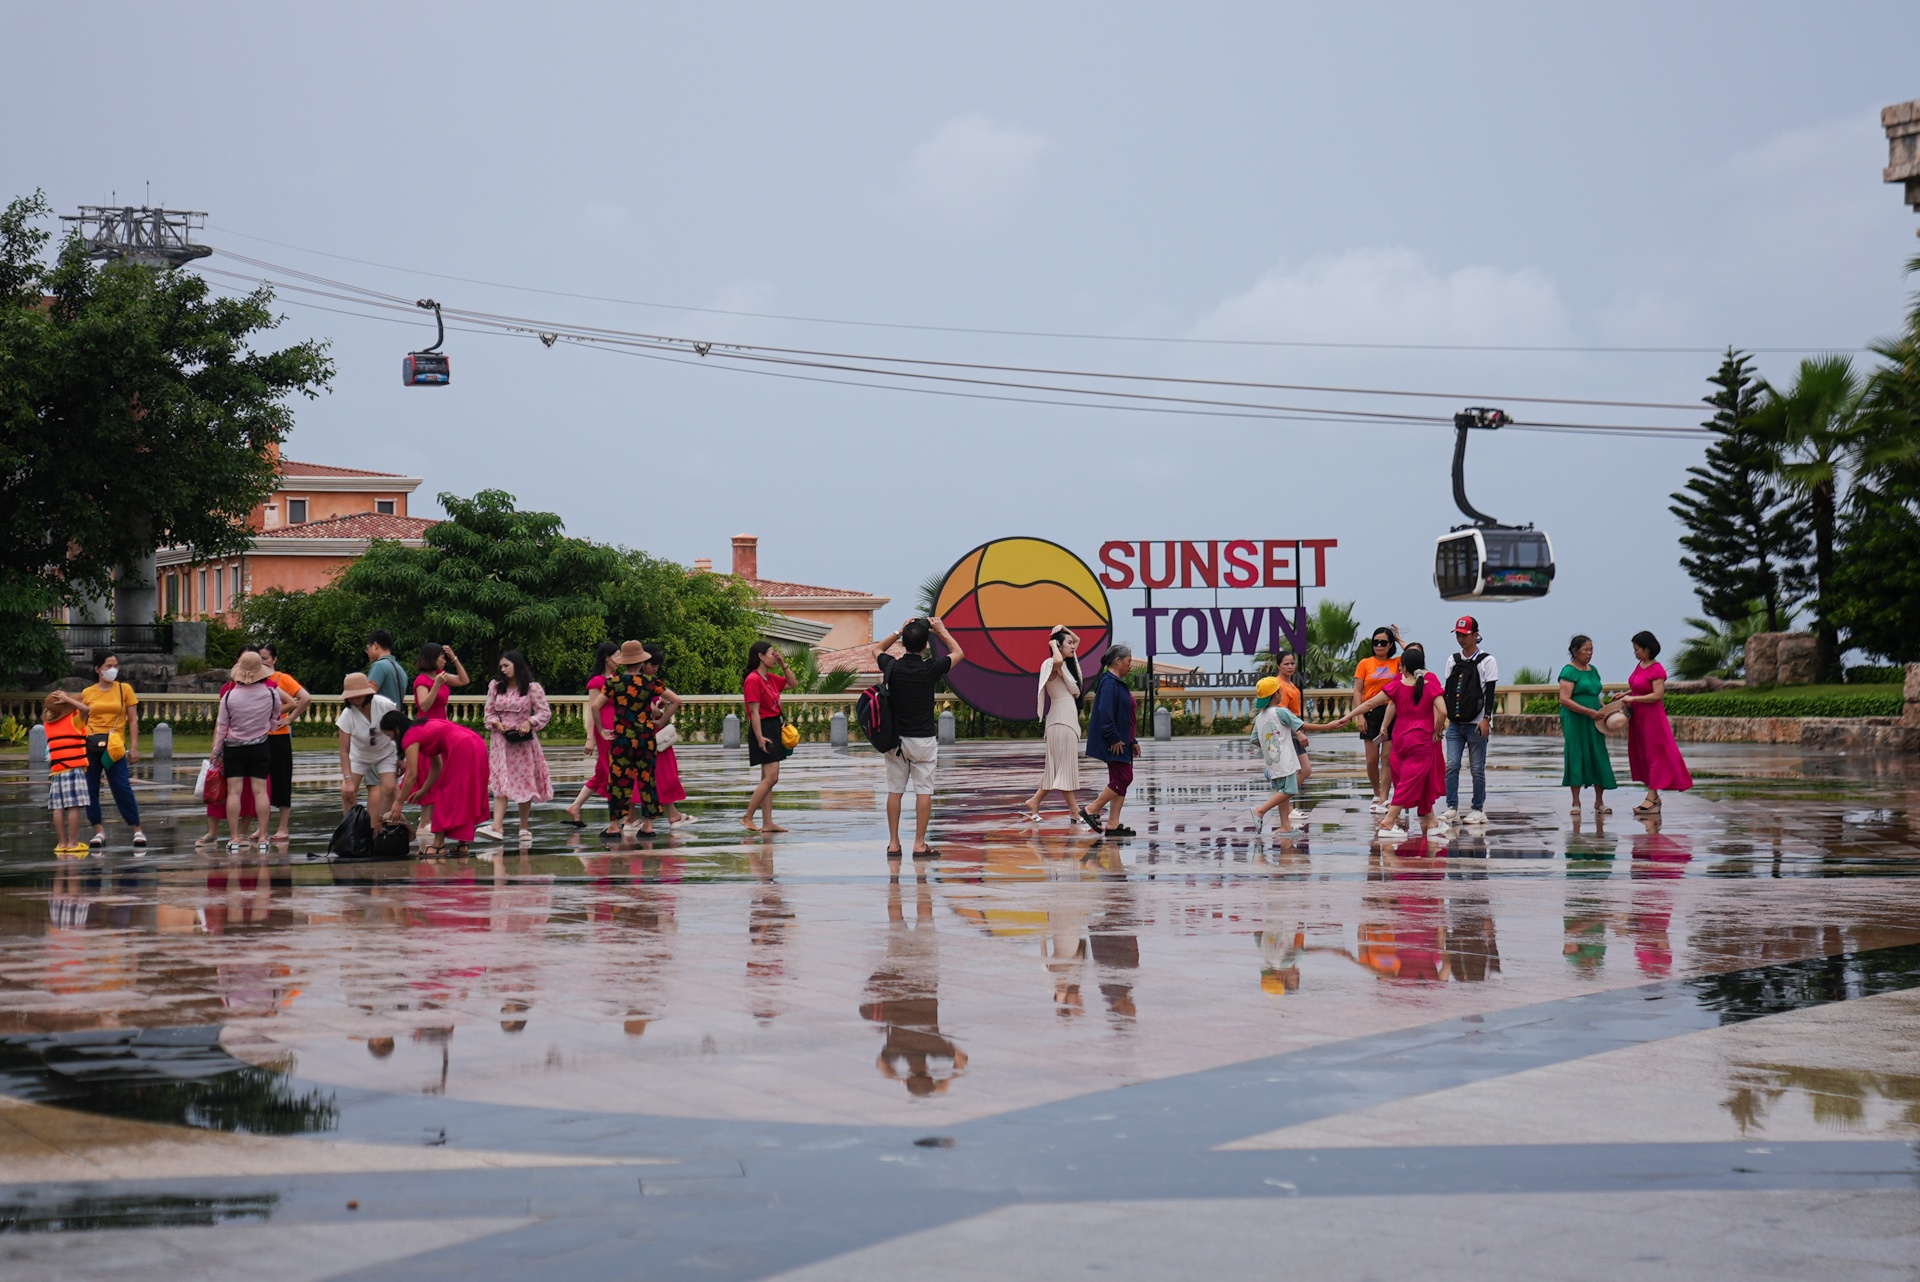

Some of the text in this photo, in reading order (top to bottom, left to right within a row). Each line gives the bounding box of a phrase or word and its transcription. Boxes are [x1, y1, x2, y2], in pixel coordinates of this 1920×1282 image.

[1099, 539, 1338, 589] SUNSET
[1132, 607, 1307, 657] TOWN
[1216, 669, 1267, 687] HOÀN
